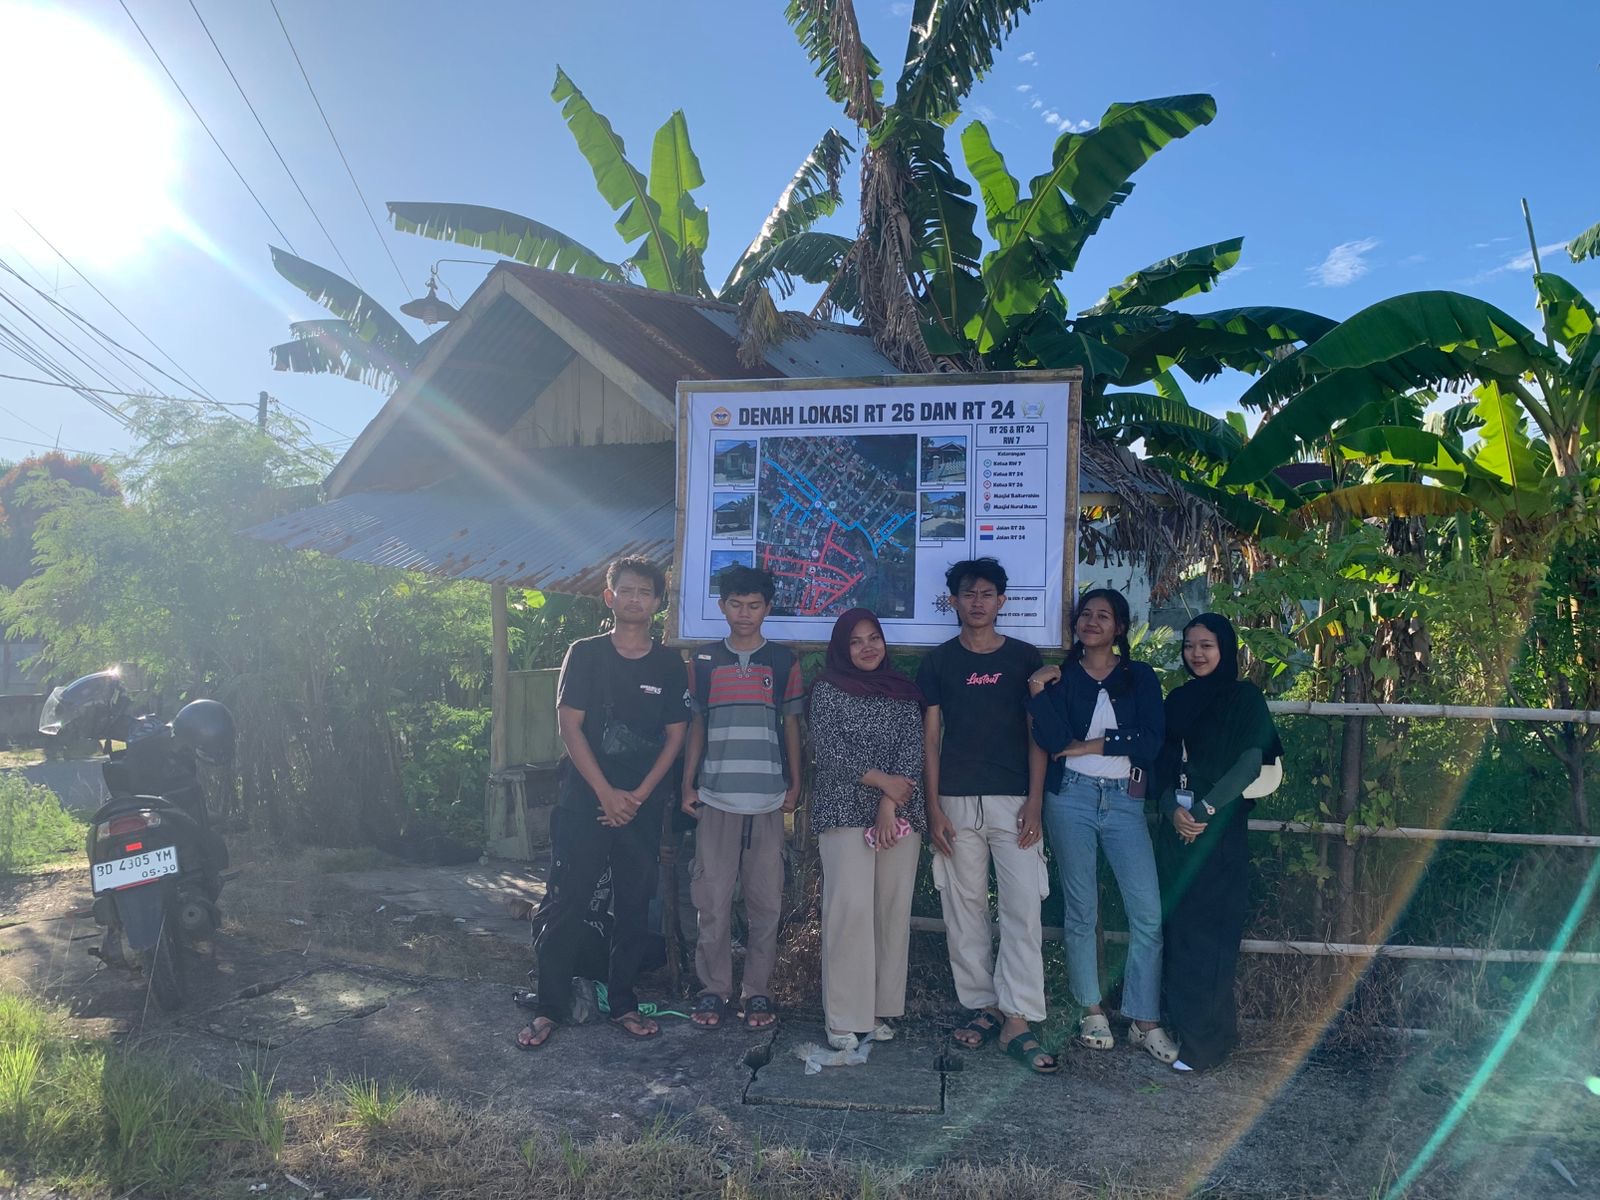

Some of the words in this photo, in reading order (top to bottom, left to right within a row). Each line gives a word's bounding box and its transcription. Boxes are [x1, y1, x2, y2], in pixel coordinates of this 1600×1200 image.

[739, 407, 794, 426] DENAH
[799, 405, 859, 425] LOKASI
[864, 404, 886, 423] RT
[891, 403, 915, 422] 26
[920, 402, 957, 421] DAN
[962, 401, 986, 420] RT
[991, 400, 1015, 420] 24
[989, 426, 998, 434] RT
[1000, 426, 1008, 434] 26
[1026, 425, 1034, 433] 24
[1003, 436, 1014, 444] RW
[1016, 436, 1020, 444] 7
[119, 854, 150, 871] 4305
[155, 849, 172, 862] YM
